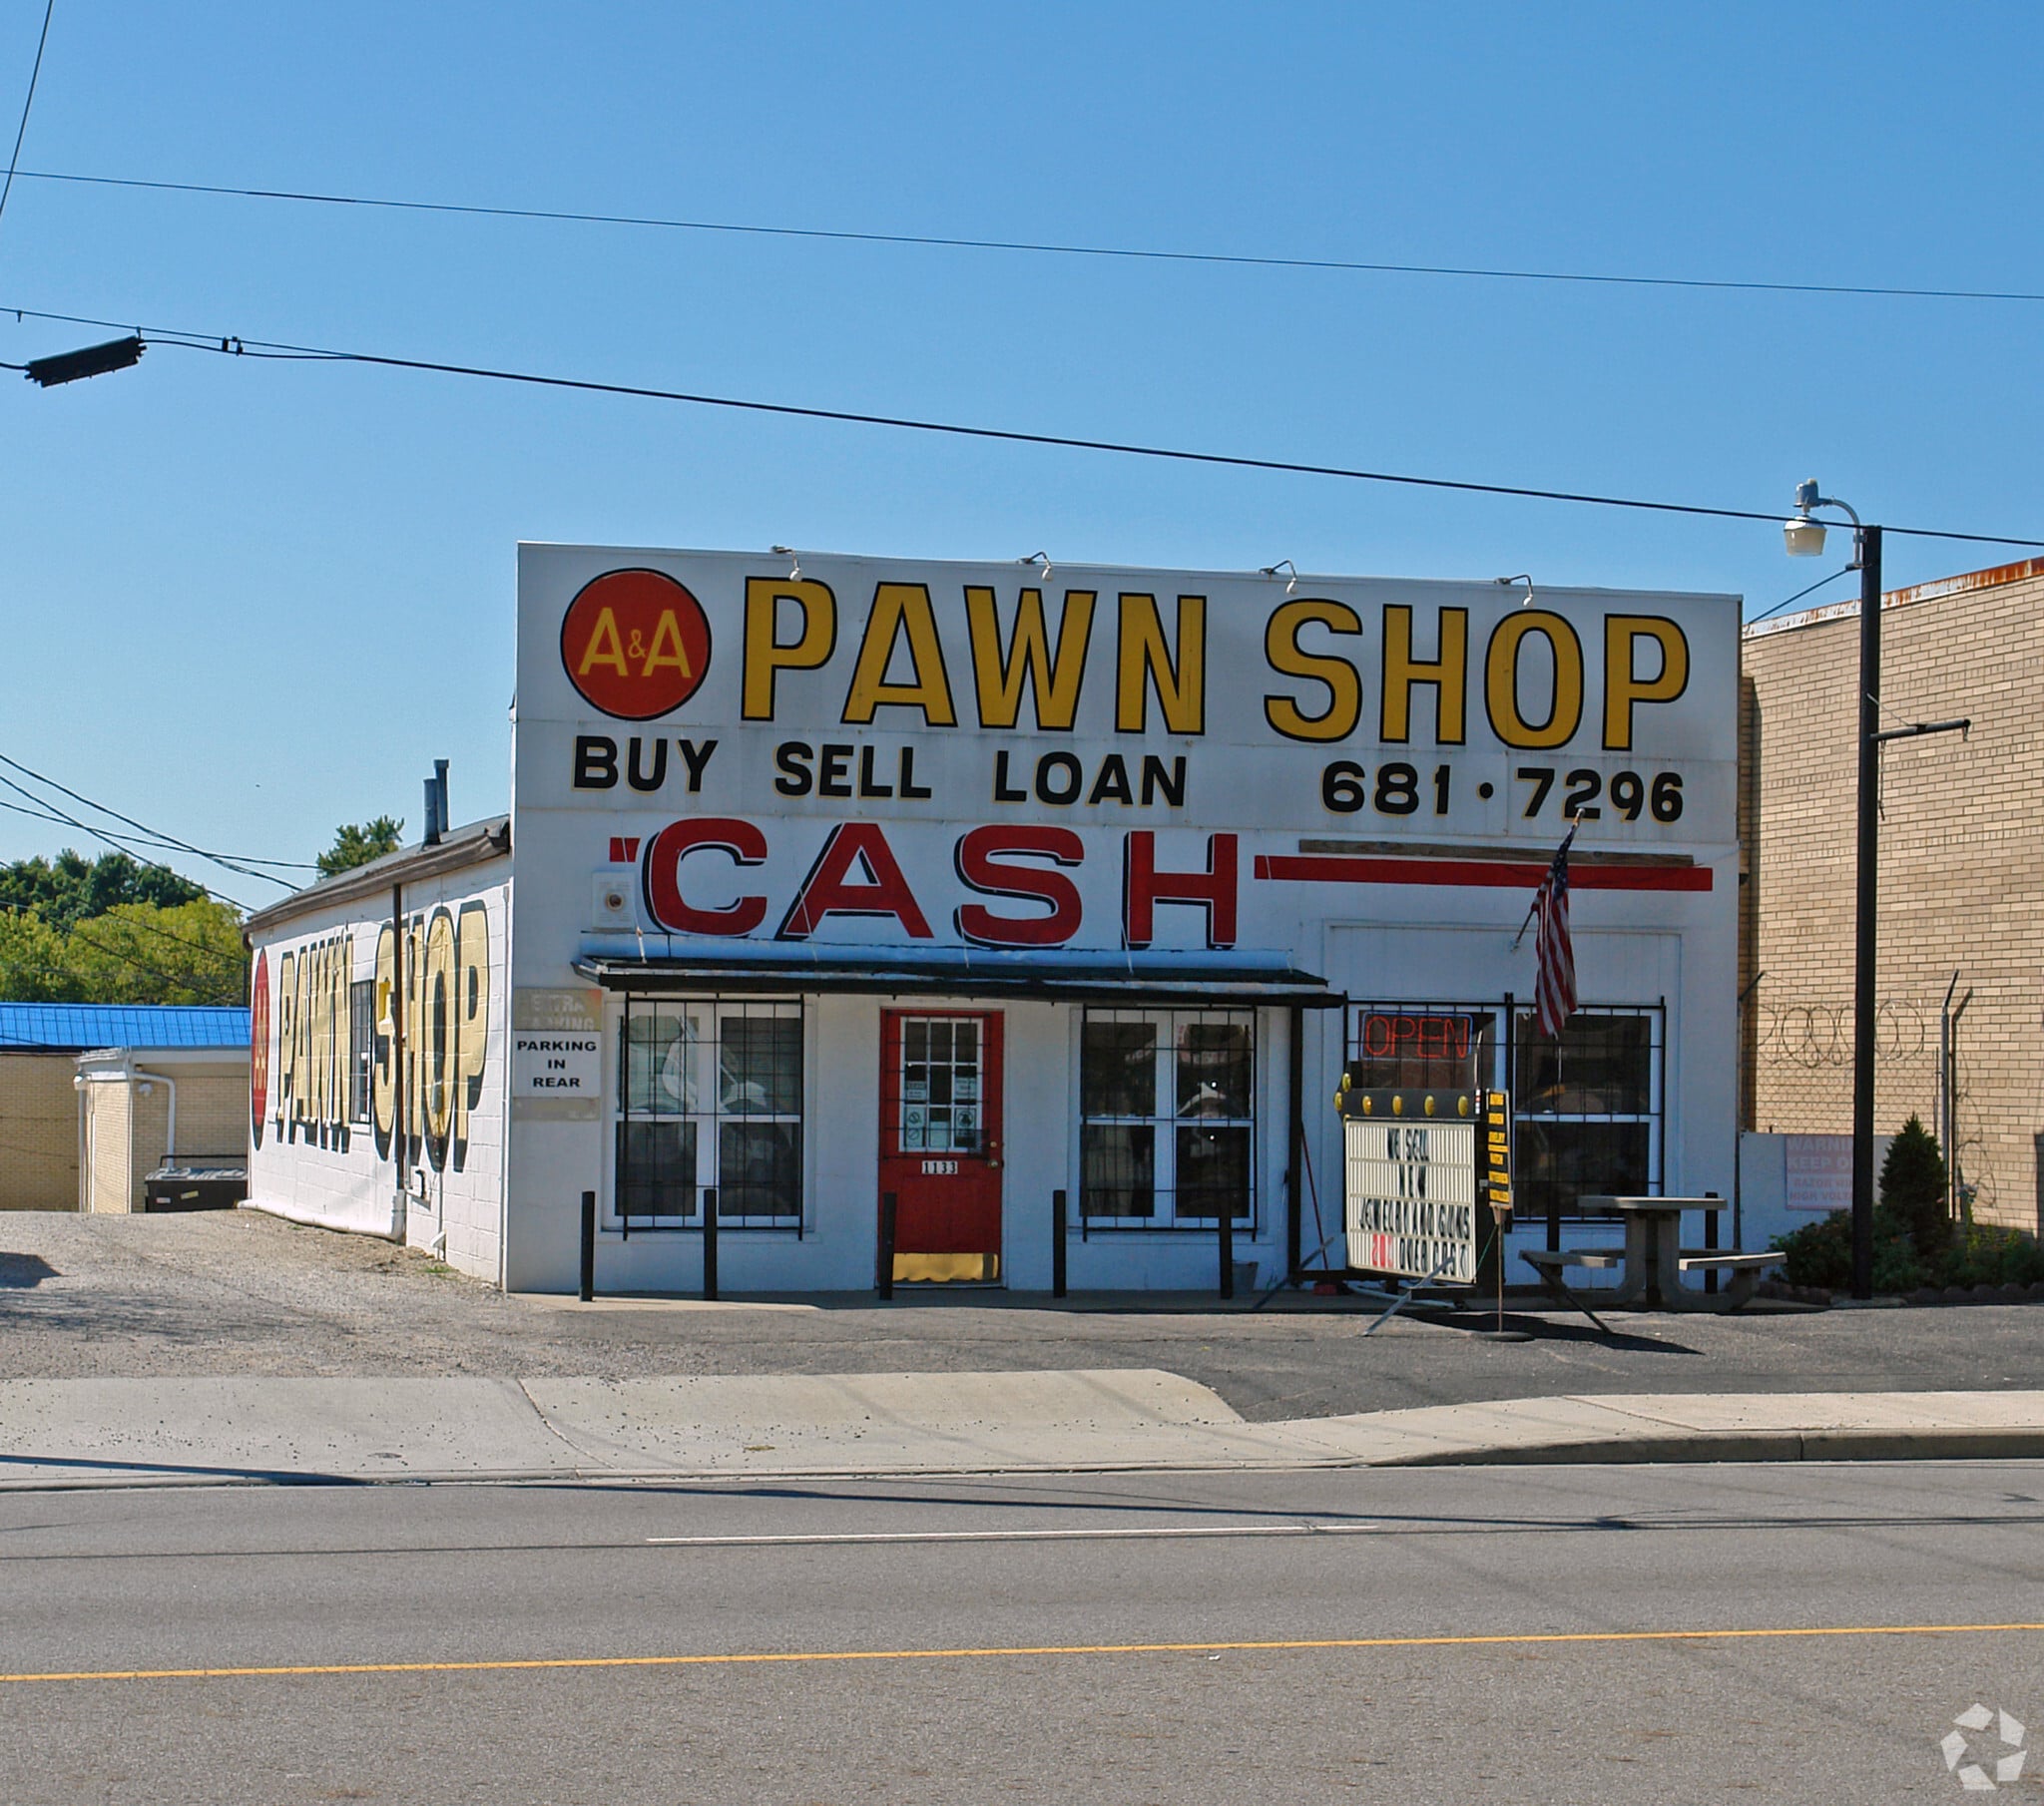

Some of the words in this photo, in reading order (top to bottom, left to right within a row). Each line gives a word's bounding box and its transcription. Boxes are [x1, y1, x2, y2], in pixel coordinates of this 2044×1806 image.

[578, 607, 692, 678] A&A
[741, 576, 1207, 736] PAWN
[1264, 598, 1691, 751] SHOP
[573, 734, 719, 793] BUY
[773, 740, 932, 799] SELL
[992, 749, 1188, 807] LOAN
[1320, 759, 1450, 816] 681
[1515, 766, 1685, 823] 7296
[643, 817, 1238, 951] CASH
[276, 929, 353, 1154] PAWN
[372, 899, 489, 1173] SHOP
[517, 1041, 597, 1052] PARKING
[1365, 1016, 1469, 1059] OPEN
[532, 1077, 581, 1088] REAR
[547, 1059, 566, 1070] IN
[1387, 1129, 1400, 1159] WE
[1405, 1129, 1429, 1161] SELL
[1788, 1156, 1832, 1169] KEEP
[923, 1161, 957, 1174] 1133
[1398, 1164, 1426, 1197] NEW
[1438, 1203, 1470, 1239] GUNS
[1399, 1237, 1428, 1273] OVER
